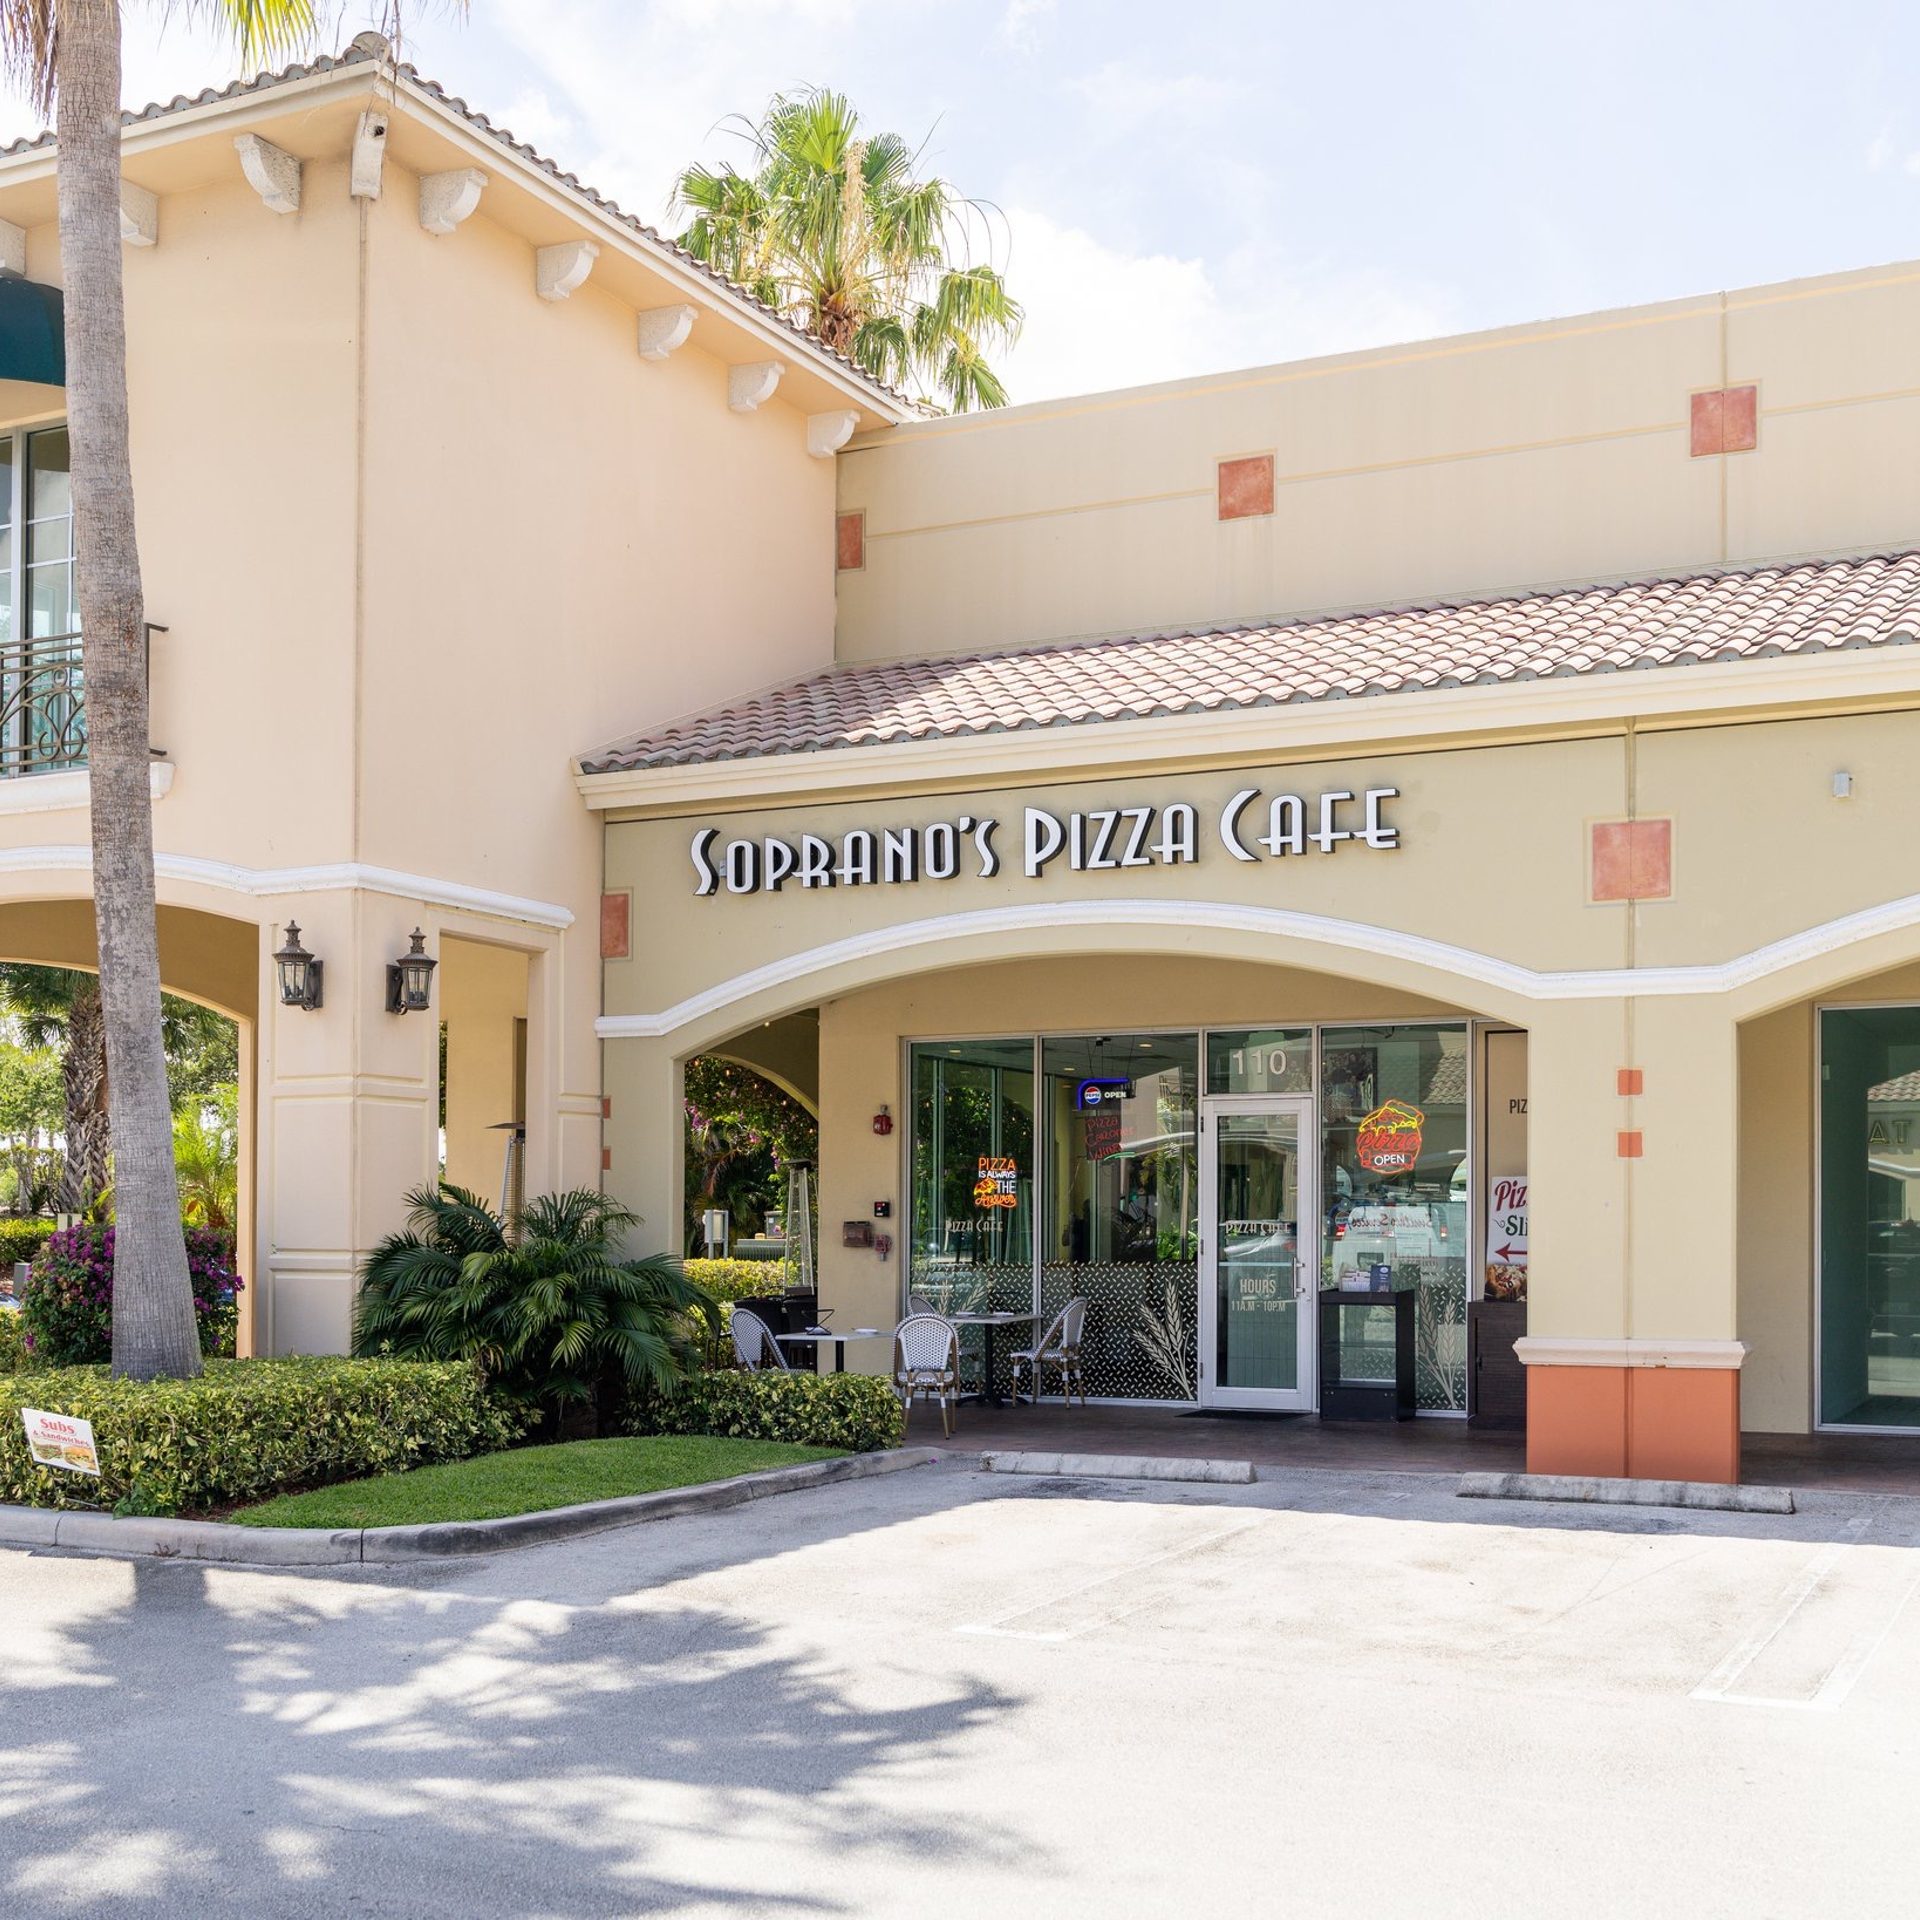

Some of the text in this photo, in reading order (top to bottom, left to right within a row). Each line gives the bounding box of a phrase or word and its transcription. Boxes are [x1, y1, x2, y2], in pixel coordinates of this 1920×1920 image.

[690, 787, 1400, 896] SOPRANO'S PIZZA CAFE
[1233, 1049, 1287, 1075] 110
[1103, 1091, 1127, 1099] OPEN
[978, 1157, 1016, 1171] PIZZA
[1374, 1154, 1405, 1166] OPEN
[978, 1170, 1016, 1179] IS ALWAYS
[996, 1179, 1017, 1194] THE
[1240, 1279, 1277, 1294] HOURS
[40, 1418, 76, 1434] Subs
